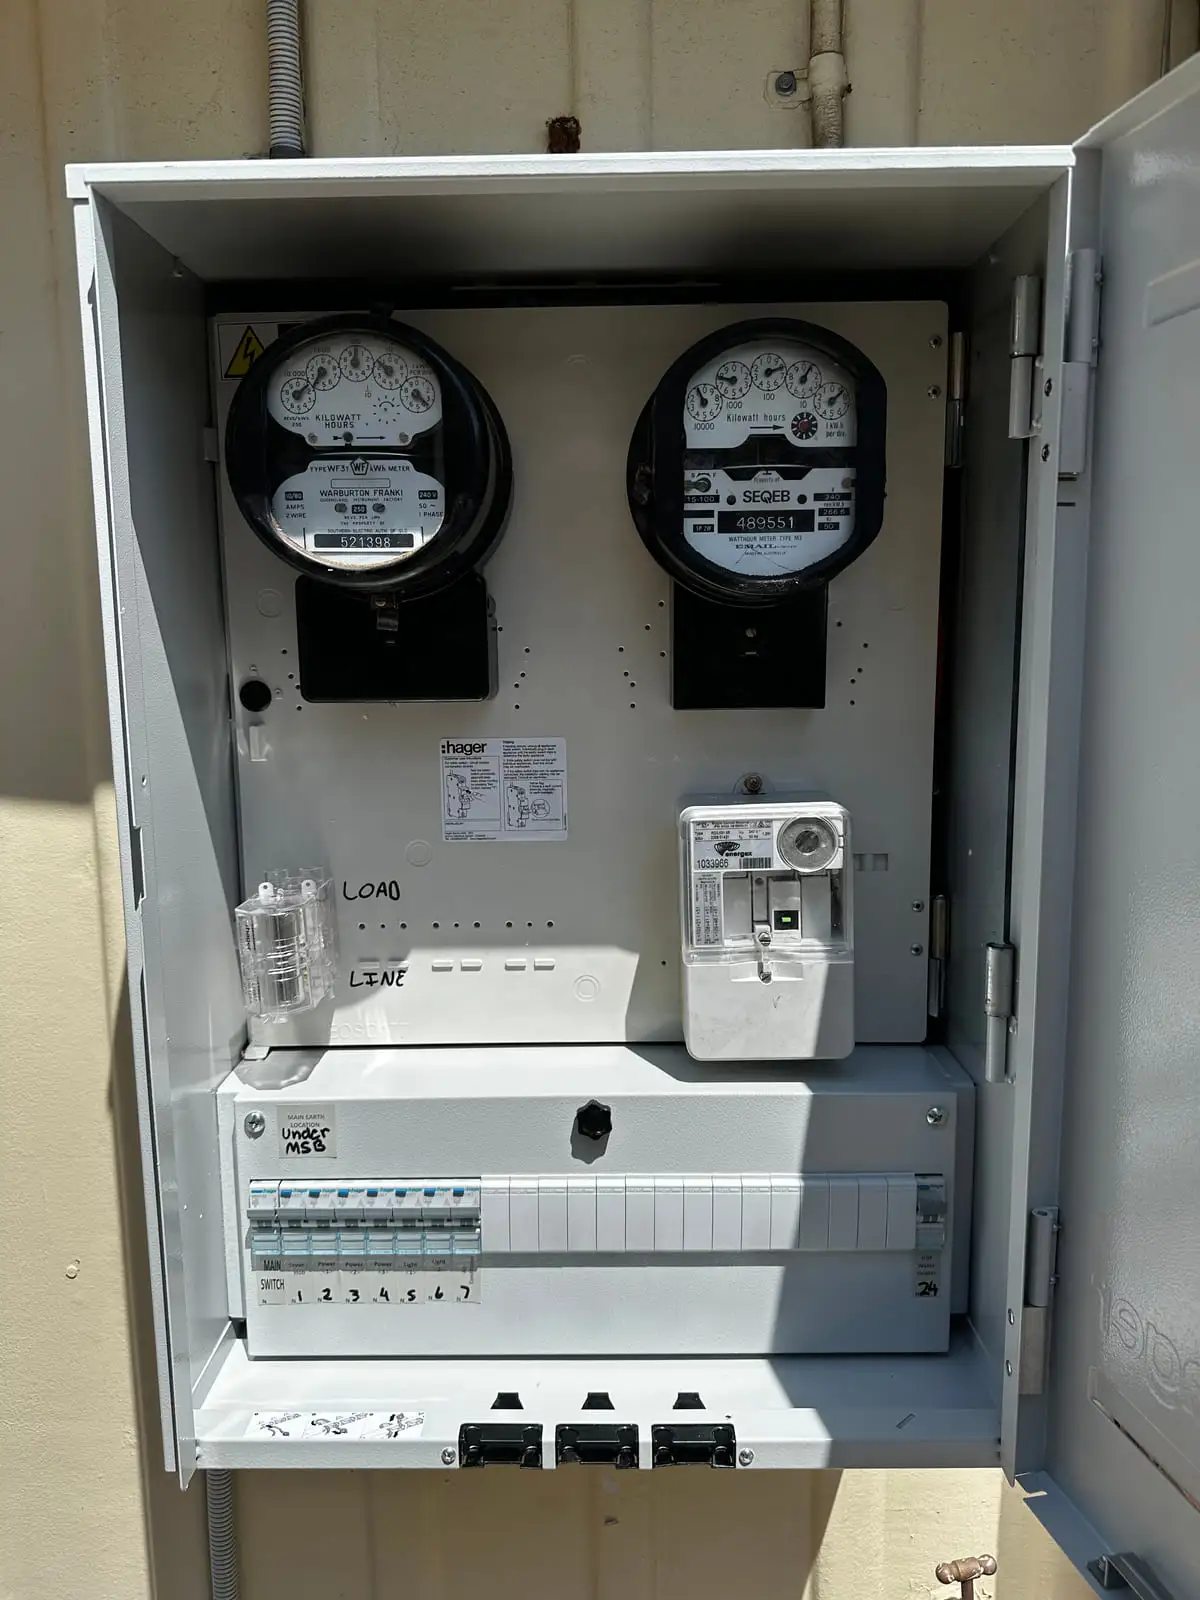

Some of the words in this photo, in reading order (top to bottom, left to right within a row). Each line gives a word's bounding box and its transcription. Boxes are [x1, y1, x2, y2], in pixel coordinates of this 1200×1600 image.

[763, 393, 775, 401] 100
[726, 401, 742, 409] 1000
[800, 400, 807, 408] 10
[727, 413, 759, 422] Kilowatt
[325, 421, 354, 429] HOURS
[354, 462, 366, 470] WF
[742, 490, 791, 504] SEQEB
[736, 516, 794, 529] 489551
[340, 536, 391, 548] 521398
[343, 880, 400, 901] LOAD
[350, 970, 407, 988] LINE
[282, 1127, 331, 1140] Under
[286, 1139, 327, 1155] MSB
[264, 1259, 281, 1271] MAIN
[261, 1279, 285, 1290] SWITCH
[918, 1280, 938, 1297] 24
[298, 1290, 302, 1302] 1
[322, 1288, 333, 1301] 2
[349, 1289, 360, 1302] 3
[380, 1287, 390, 1301] 4
[407, 1289, 416, 1301] 5
[434, 1286, 444, 1299] 6
[460, 1285, 470, 1299] 7
